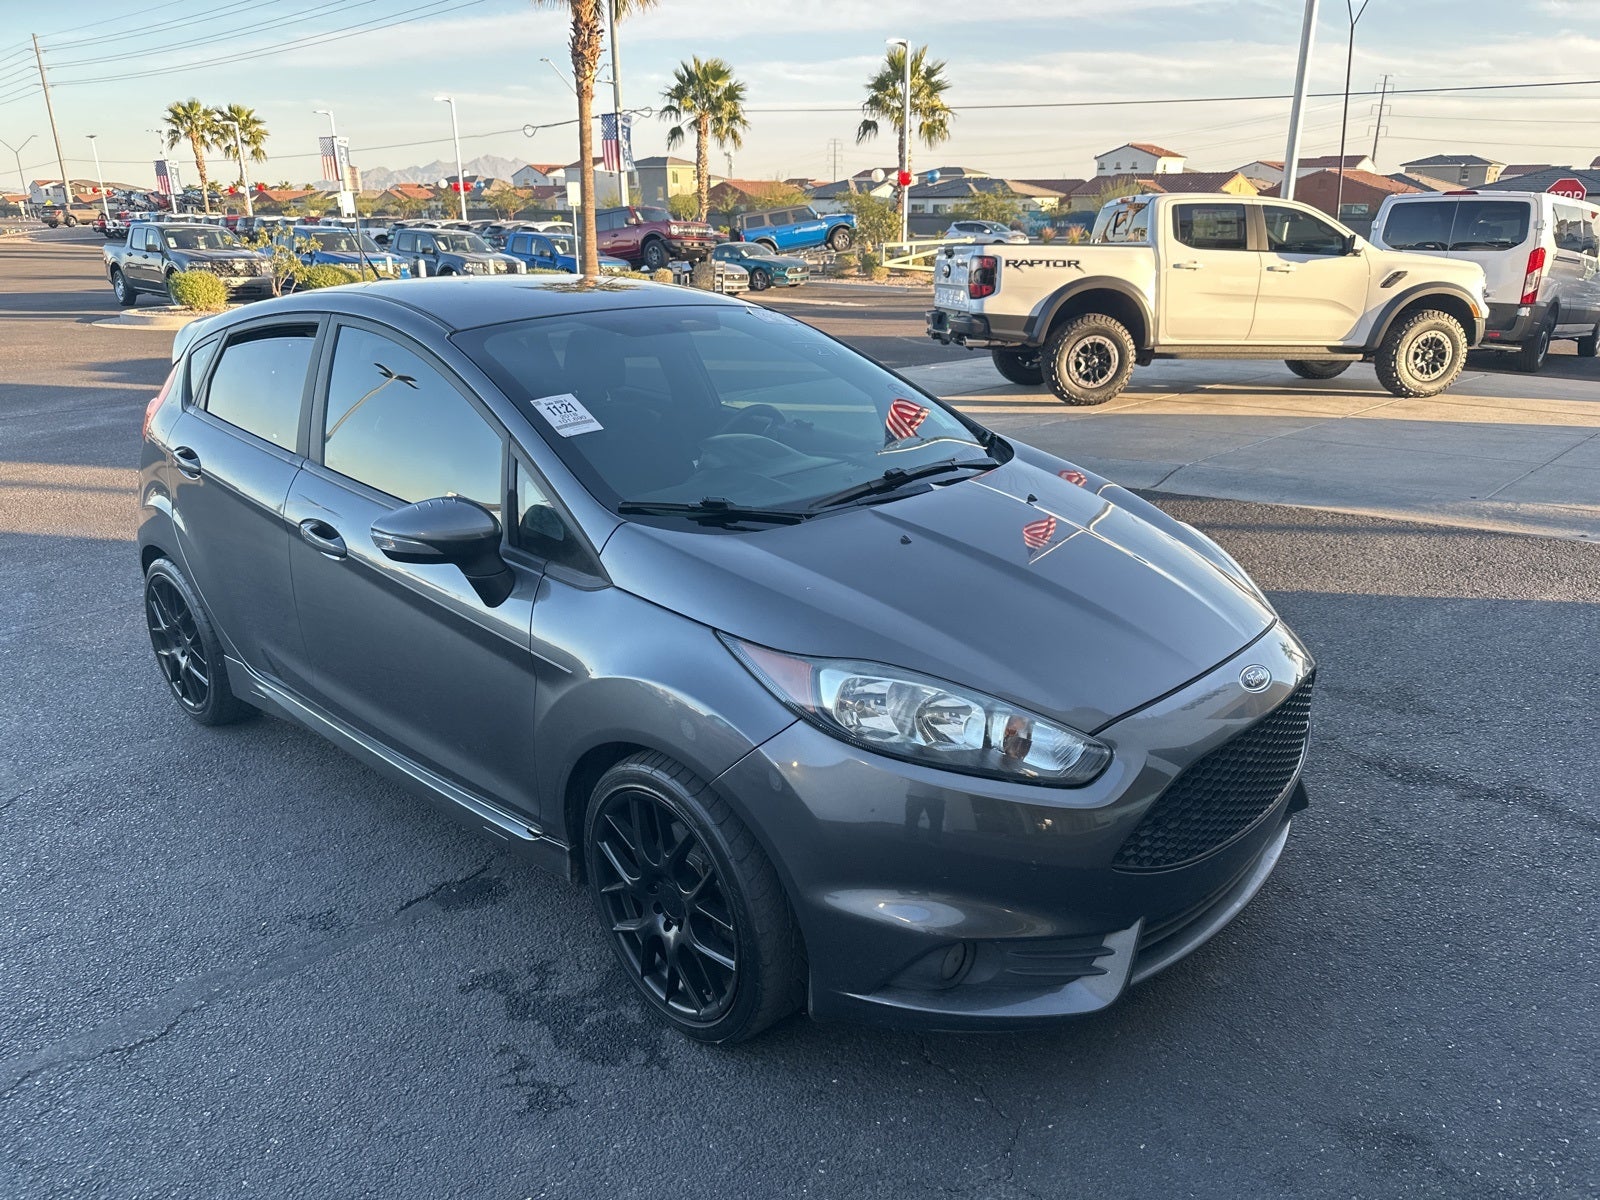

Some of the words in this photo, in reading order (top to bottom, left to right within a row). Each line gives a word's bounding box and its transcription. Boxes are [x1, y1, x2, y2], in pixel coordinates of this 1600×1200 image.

[1550, 190, 1583, 200] OP
[1005, 259, 1085, 273] RAPTOR
[547, 402, 577, 416] 11:21
[1246, 670, 1265, 687] Ford
